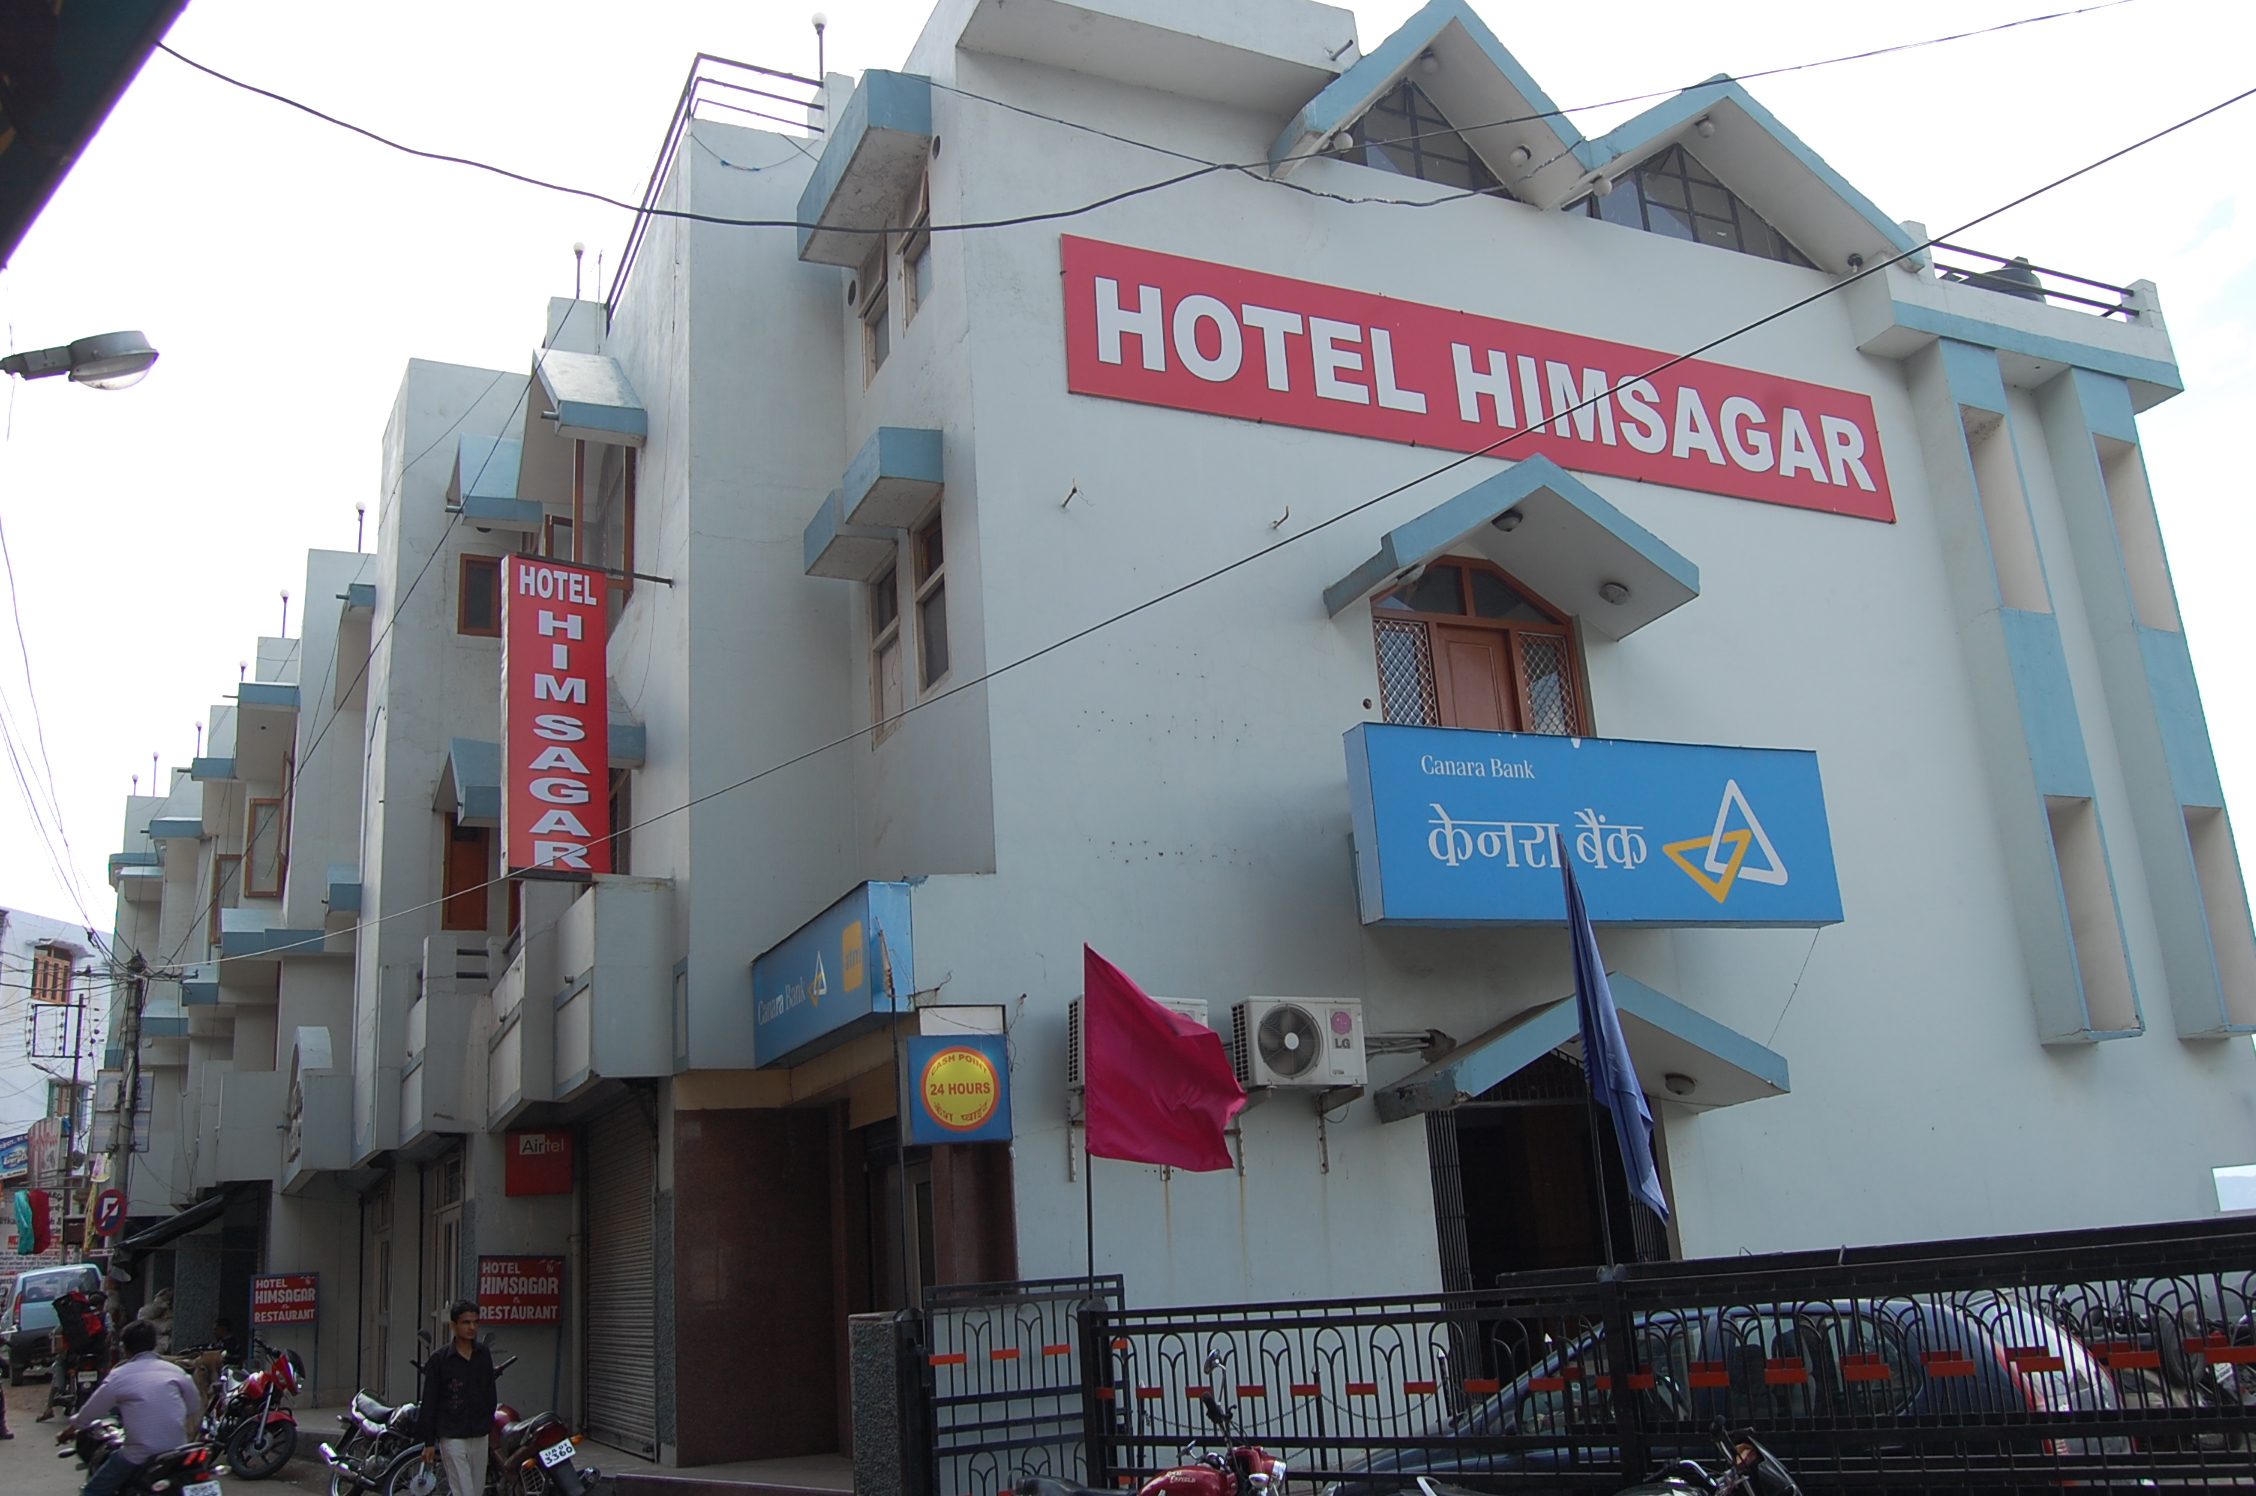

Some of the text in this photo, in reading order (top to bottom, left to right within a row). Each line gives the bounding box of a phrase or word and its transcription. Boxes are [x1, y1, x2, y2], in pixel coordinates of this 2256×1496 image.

[1094, 275, 1878, 493] HOTEL HIMSAGAR
[518, 564, 597, 606] HOTEL
[528, 609, 592, 869] HIMSAGAR
[1420, 754, 1536, 779] Canara Bank
[1427, 803, 1648, 870] केनरा बैंक
[758, 976, 806, 1026] Canara Bank
[1334, 1037, 1351, 1050] LG
[930, 1053, 987, 1076] CASH POINT
[930, 1082, 991, 1096] 24 HOURS
[521, 1138, 565, 1154] Airtel
[482, 1262, 522, 1274] HOTEL
[256, 1278, 288, 1289] HOTEL
[480, 1276, 559, 1295] HIMSAGAR
[255, 1287, 316, 1304] HIMSAGAR
[254, 1309, 315, 1323] RESTAURANT
[479, 1305, 558, 1320] RESTAURANT
[544, 1446, 573, 1465] 3360
